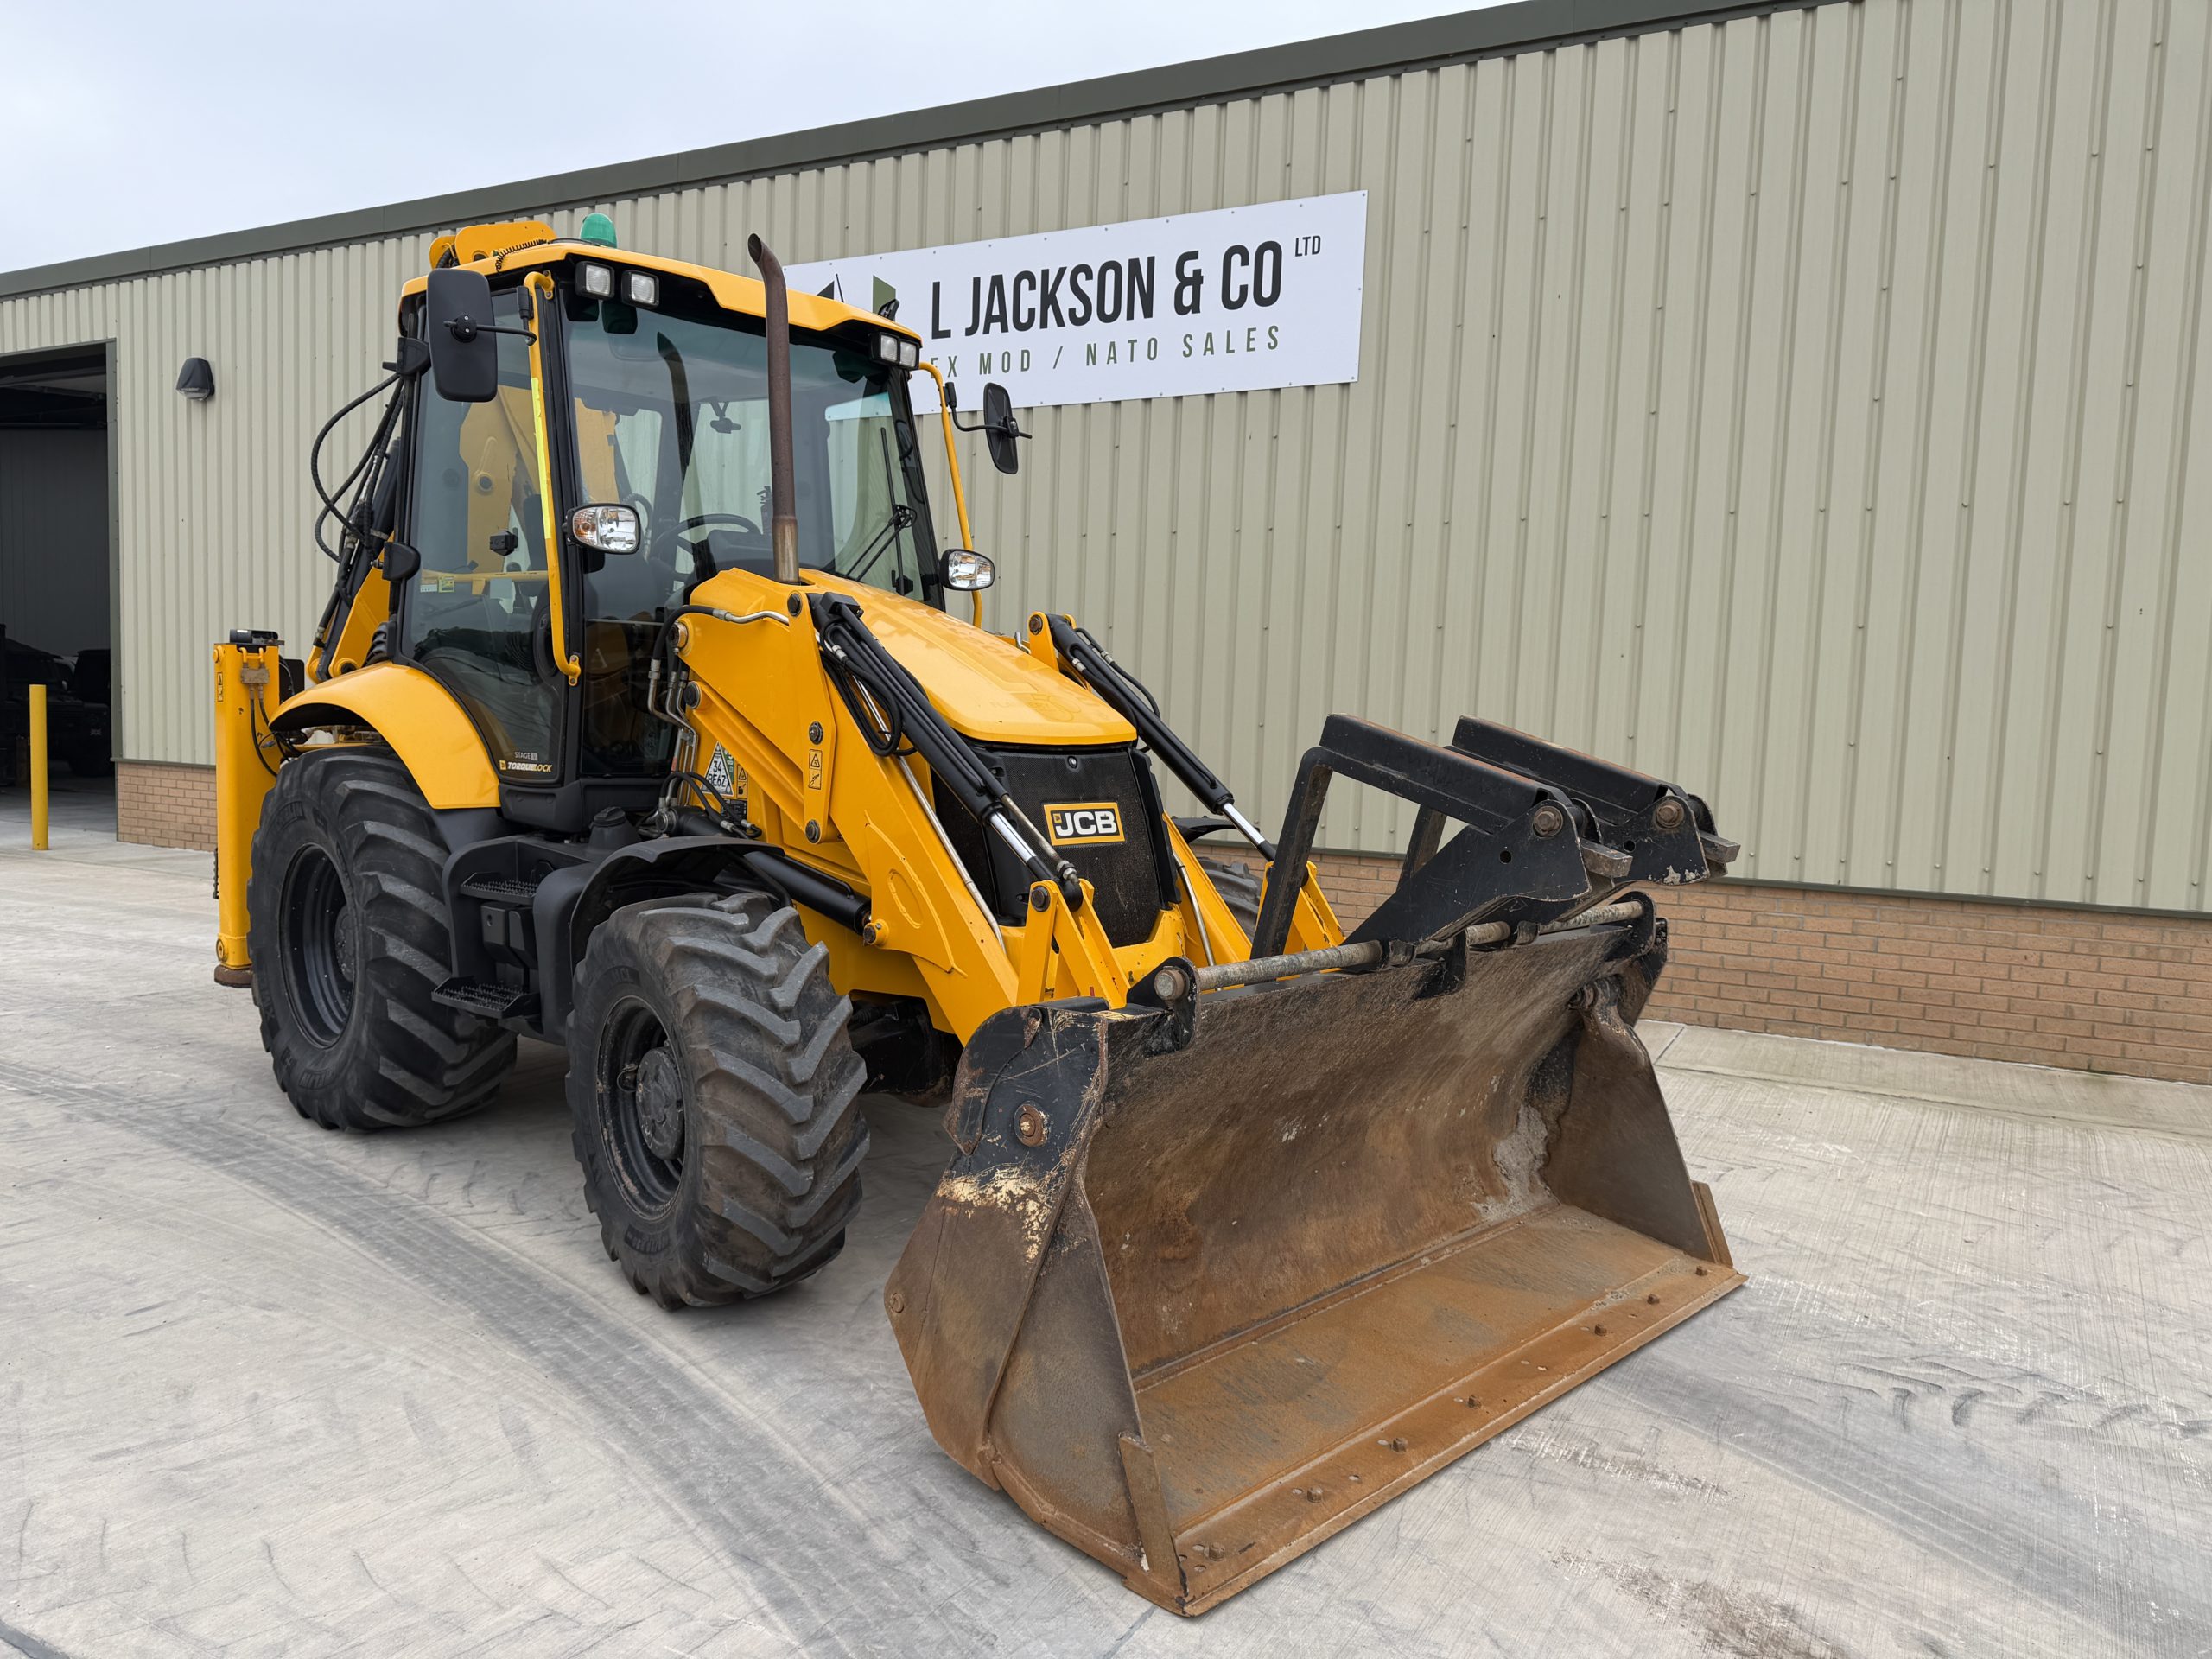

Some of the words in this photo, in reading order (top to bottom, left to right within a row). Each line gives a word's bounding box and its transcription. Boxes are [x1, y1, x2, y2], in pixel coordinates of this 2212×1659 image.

[931, 281, 951, 340] L
[964, 256, 1156, 337] JACKSON
[1173, 250, 1204, 316] &
[1221, 240, 1283, 311] CO
[1294, 235, 1321, 257] LTD
[979, 349, 1031, 375] MOD
[1052, 346, 1064, 370] /
[1086, 337, 1158, 367] NATO
[1182, 325, 1279, 358] SALES
[508, 762, 552, 772] TORQUELOCK
[713, 761, 722, 773] 34
[1055, 810, 1117, 836] JCB
